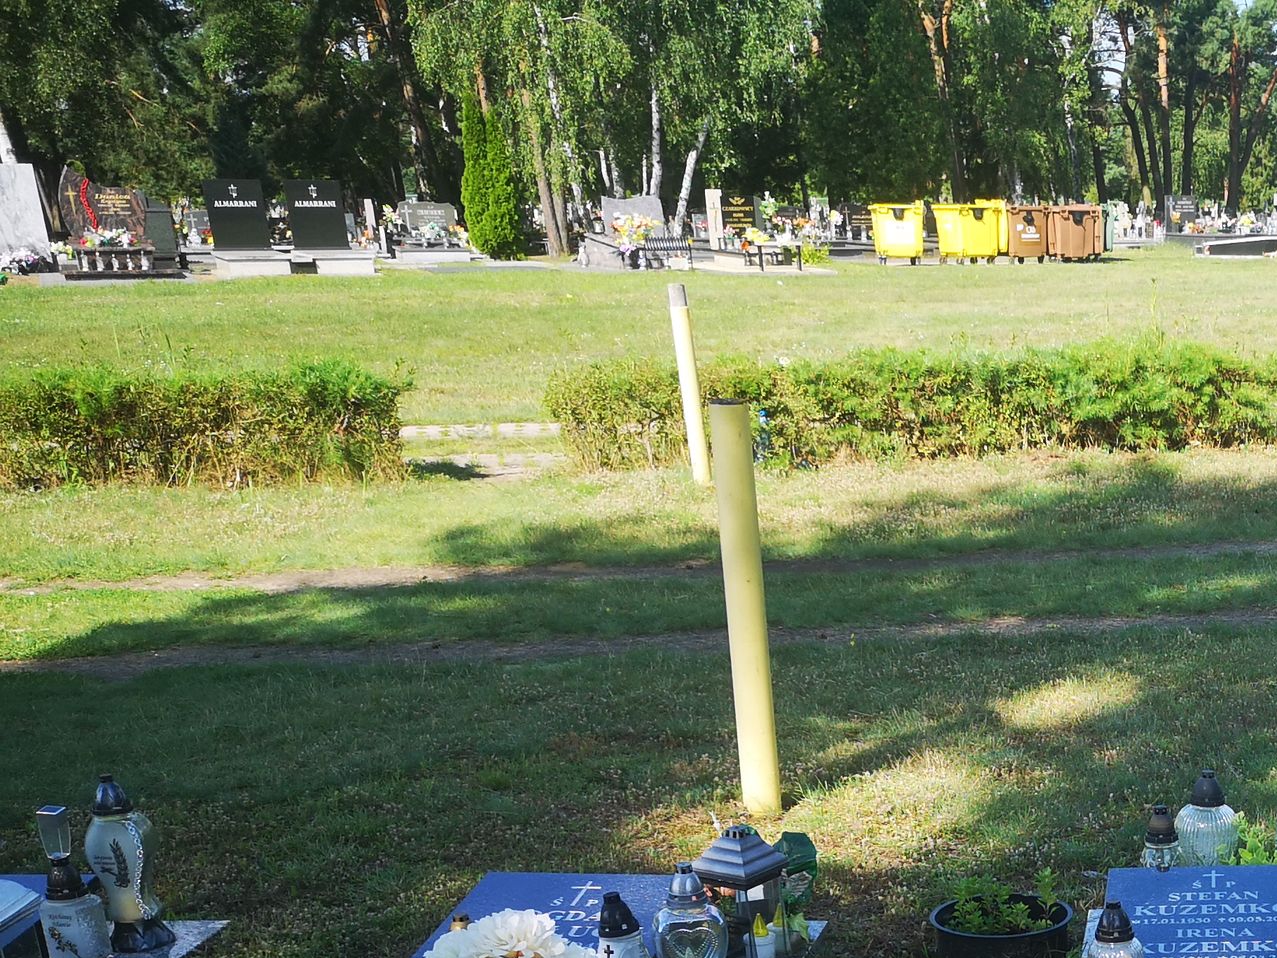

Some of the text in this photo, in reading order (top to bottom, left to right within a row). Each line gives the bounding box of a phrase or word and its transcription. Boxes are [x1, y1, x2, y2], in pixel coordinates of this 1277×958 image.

[1192, 879, 1236, 889] Ś P
[1168, 890, 1259, 902] STEFAN
[550, 896, 599, 907] Ś P
[1175, 928, 1255, 938] IRENA
